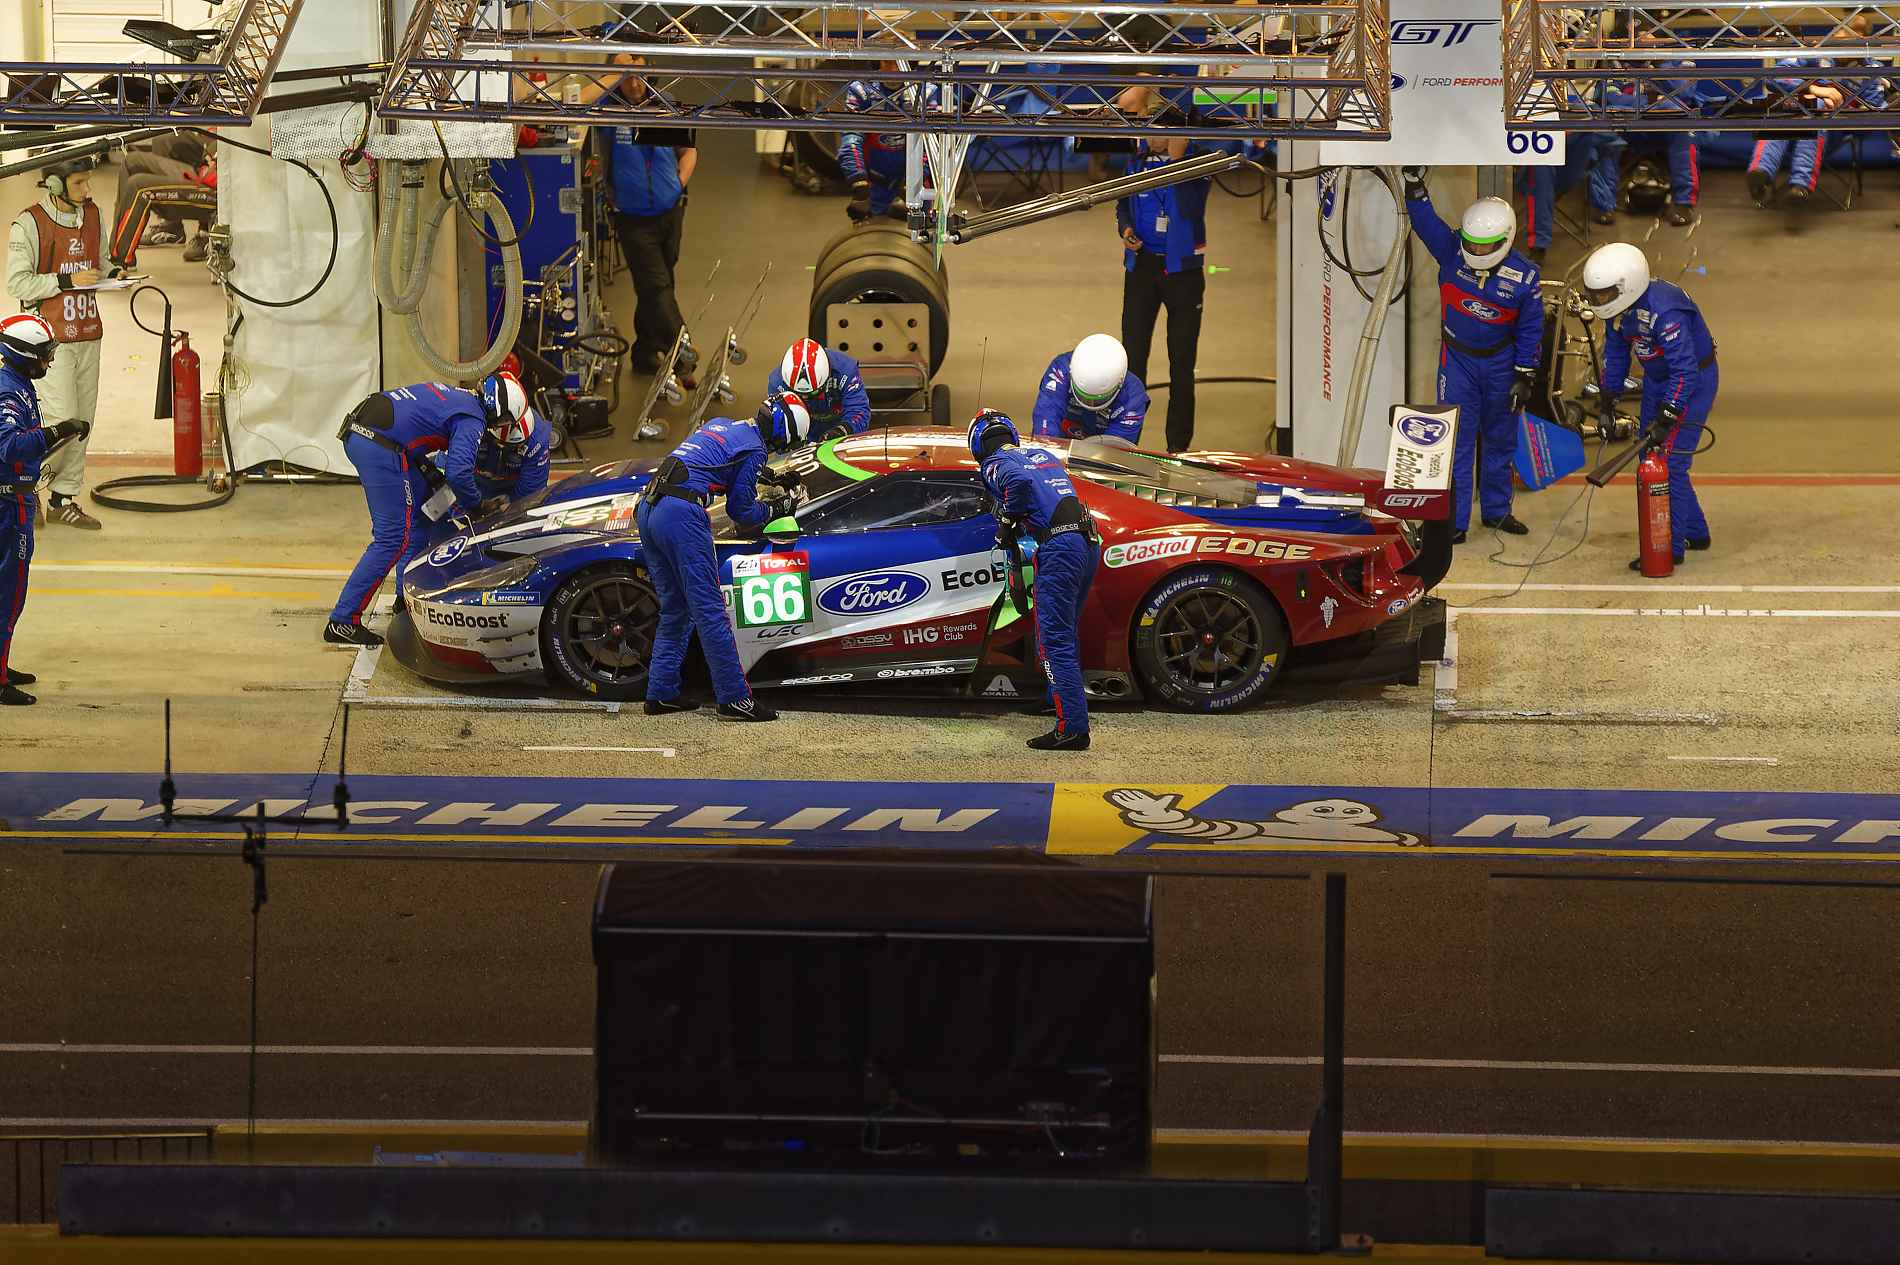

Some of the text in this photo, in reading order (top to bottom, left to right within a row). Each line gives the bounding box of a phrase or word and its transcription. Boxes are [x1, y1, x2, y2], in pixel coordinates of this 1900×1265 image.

[1422, 77, 1453, 87] FORD
[1507, 131, 1553, 155] 66
[63, 294, 97, 322] 895
[1321, 284, 1332, 402] PERFORMANCE
[404, 480, 413, 506] FORD
[1384, 494, 1443, 508] GT
[18, 532, 27, 560] FORD
[1126, 536, 1315, 562] Castrol EDGE
[761, 558, 806, 569] TOTAL
[742, 574, 805, 624] 66
[840, 577, 908, 611] Ford
[1153, 574, 1210, 607] MICHELIN
[427, 607, 507, 629] EcoBoost
[943, 622, 978, 633] Rewards
[757, 624, 804, 639] WEC
[903, 626, 939, 645] IHG
[944, 632, 964, 641] Club
[780, 673, 854, 685] sparco
[894, 666, 956, 677] brembo
[1209, 673, 1265, 709] MICHELIN
[37, 798, 1000, 832] MICHELIN
